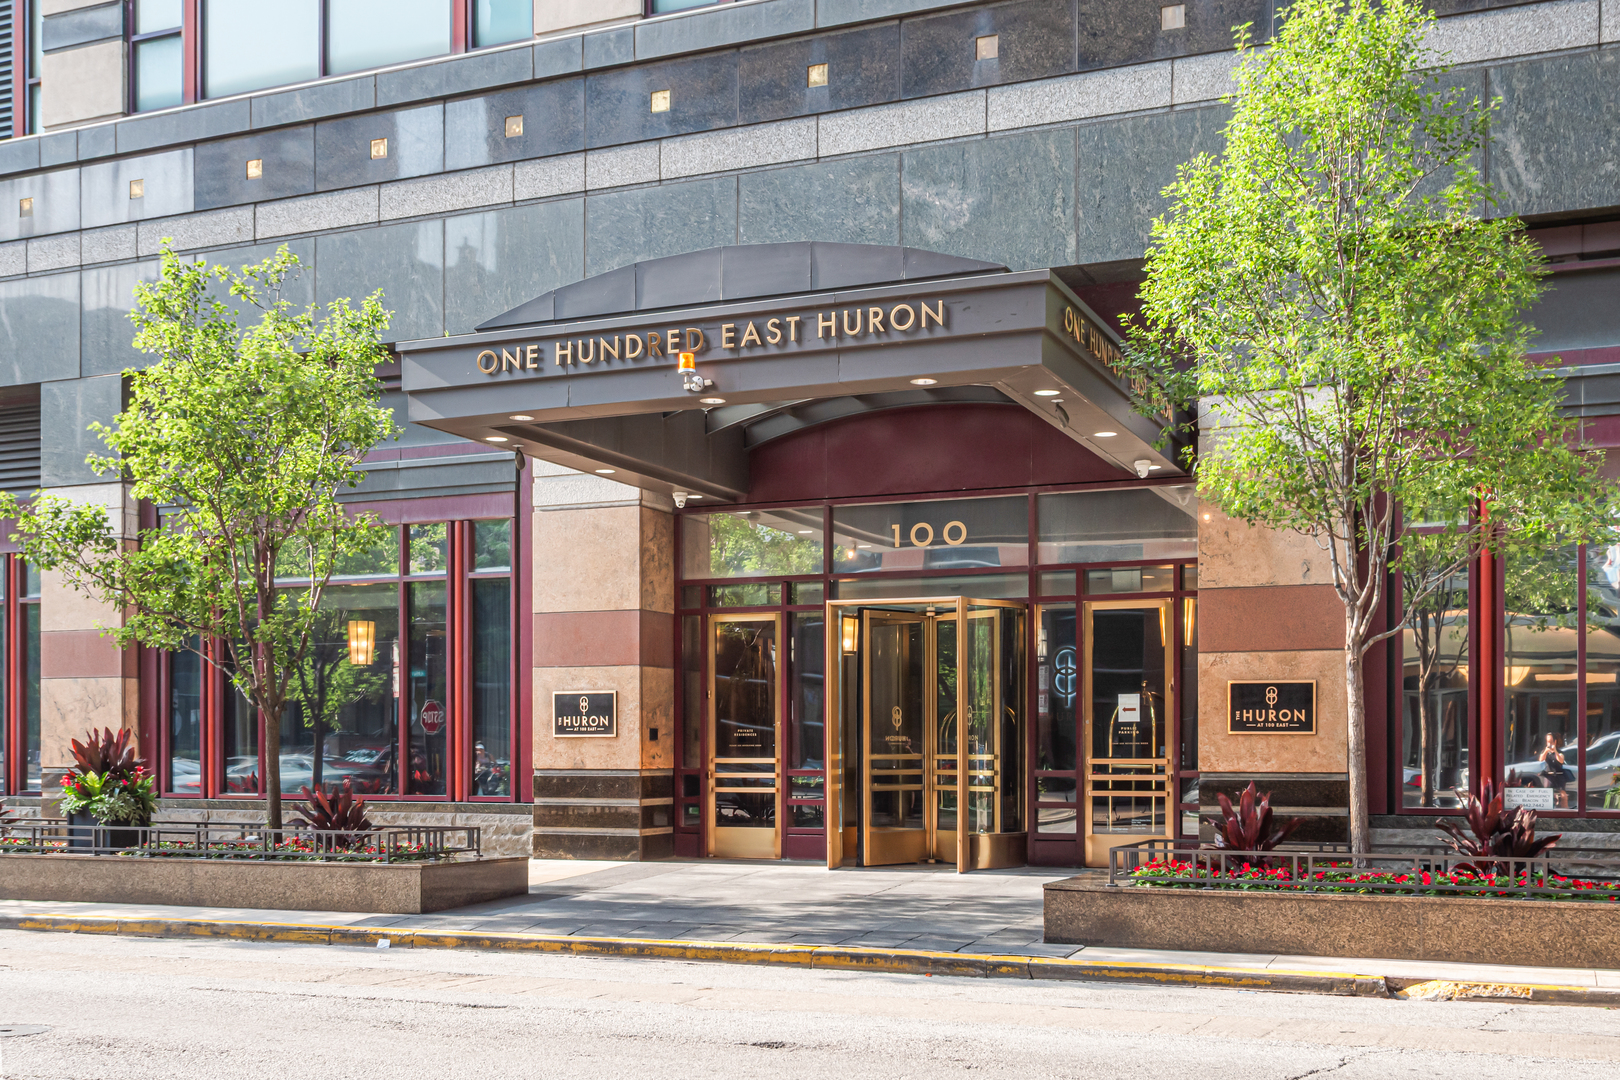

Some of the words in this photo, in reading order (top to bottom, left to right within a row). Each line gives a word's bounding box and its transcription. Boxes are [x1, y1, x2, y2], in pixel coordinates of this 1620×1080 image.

[476, 344, 540, 375] ONE
[554, 327, 705, 366] HUNDRED
[721, 315, 801, 349] EAST
[817, 300, 945, 339] HURON
[1065, 306, 1085, 345] ONE
[891, 520, 968, 548] 100
[563, 715, 609, 727] HURON
[1243, 709, 1306, 722] HURON
